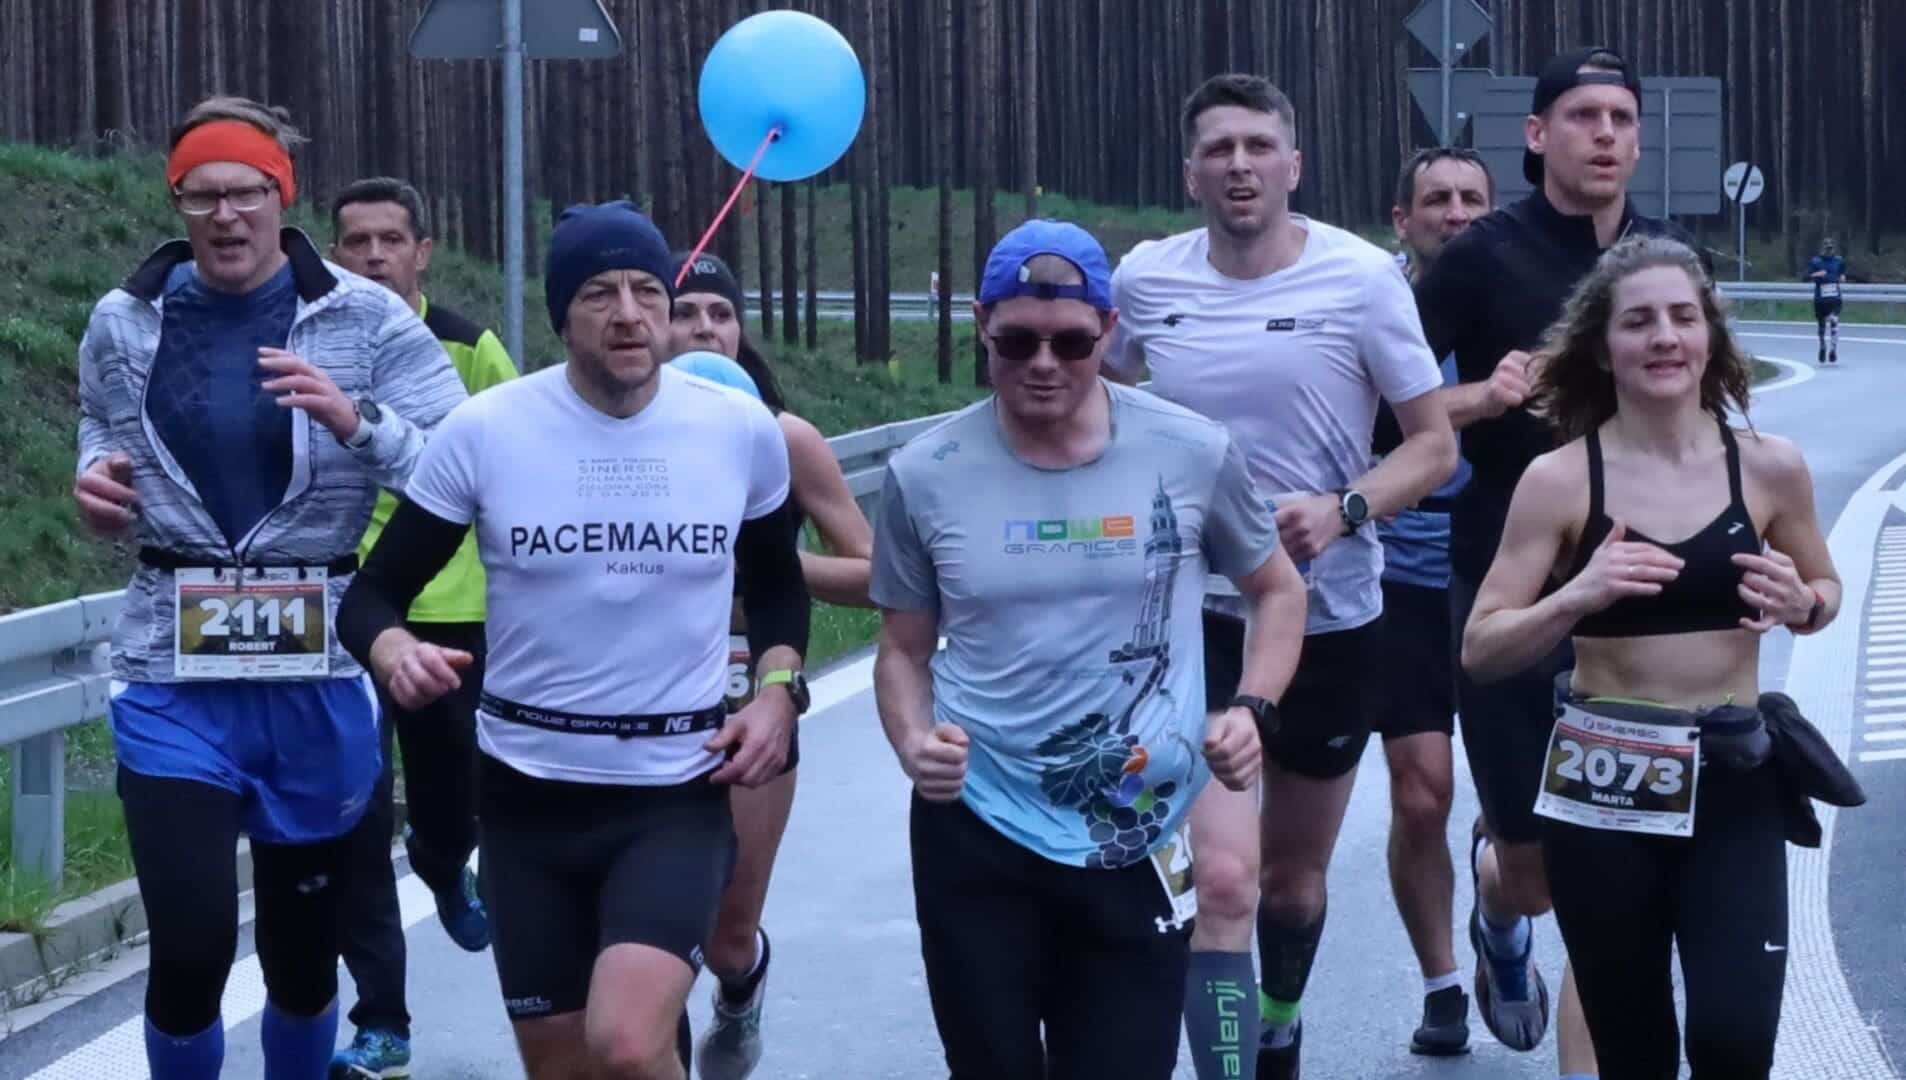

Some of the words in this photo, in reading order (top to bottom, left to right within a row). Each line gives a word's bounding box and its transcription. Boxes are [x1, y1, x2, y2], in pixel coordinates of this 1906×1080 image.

[511, 521, 728, 557] PACEMAKER
[1003, 538, 1137, 555] GRANICE
[606, 562, 665, 575] Kaktus
[200, 597, 306, 637] 2111
[228, 641, 276, 652] ROBERT
[664, 715, 693, 734] NG
[1555, 738, 1684, 795] 2073
[1591, 791, 1635, 807] MARTA
[1207, 981, 1247, 1080] alenji
